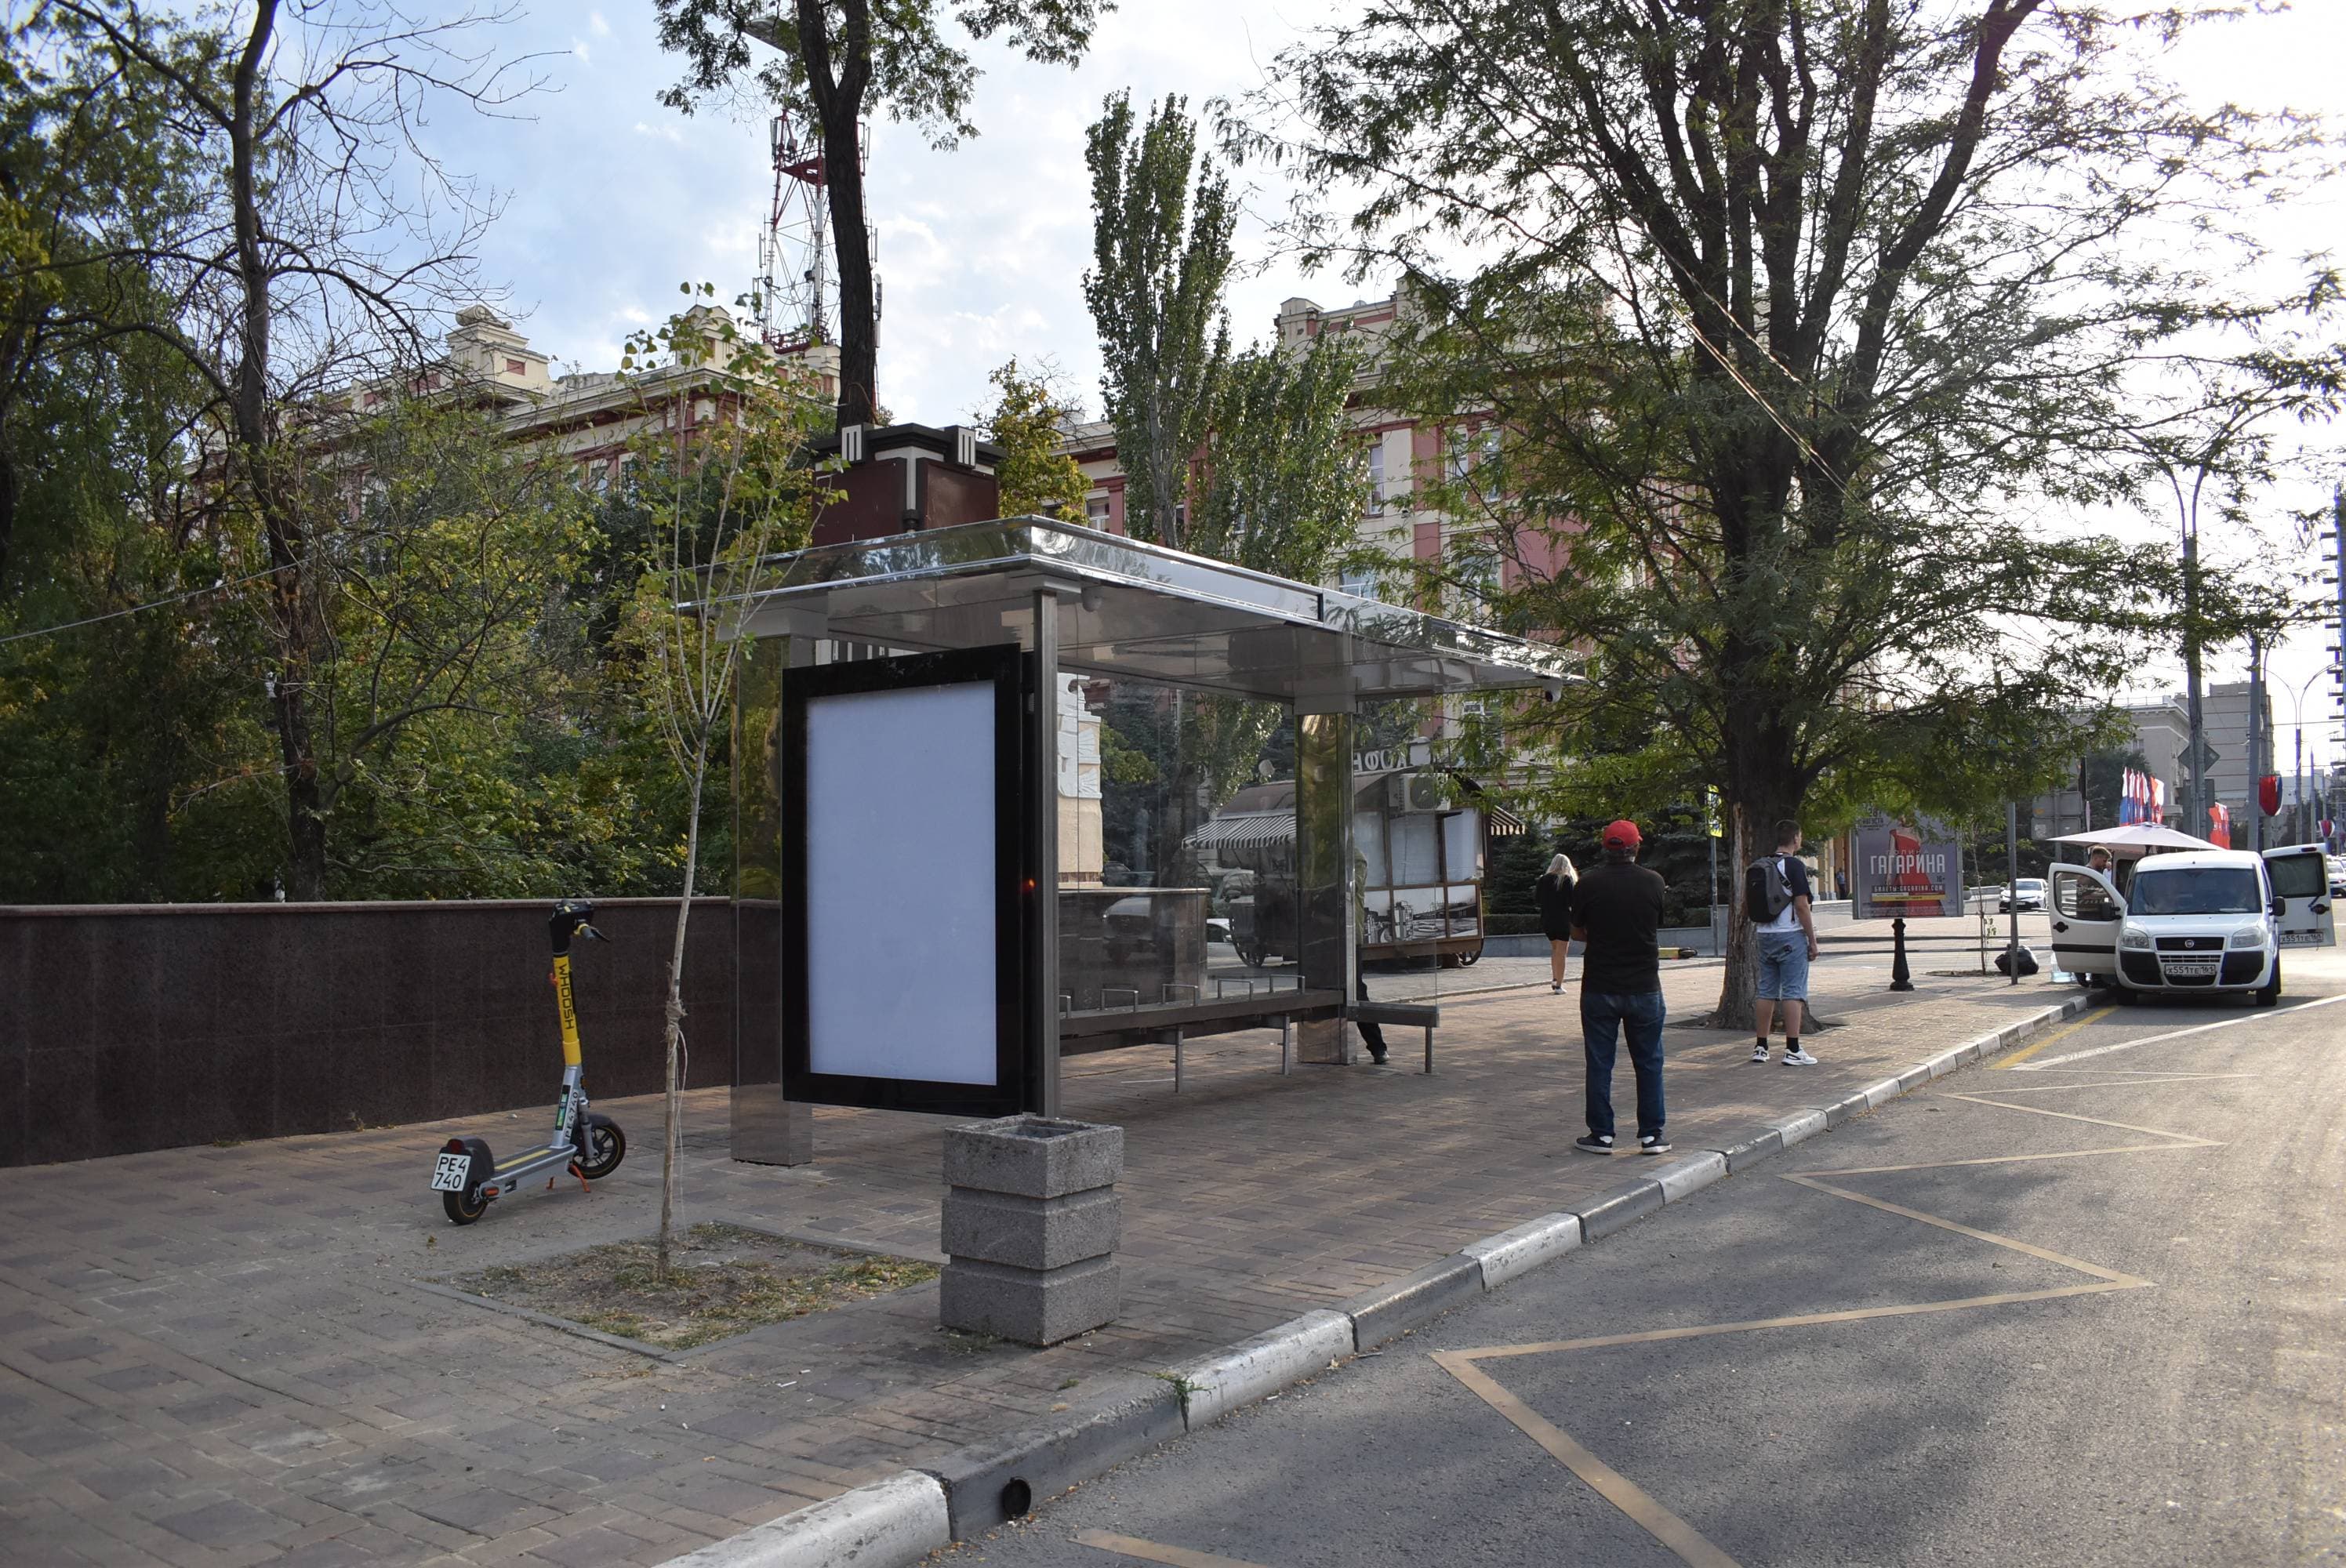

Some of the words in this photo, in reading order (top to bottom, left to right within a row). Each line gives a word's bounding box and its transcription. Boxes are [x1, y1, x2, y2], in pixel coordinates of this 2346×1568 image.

[1870, 854, 1945, 874] ГАГАРИНА
[558, 964, 575, 1029] WHOOSH
[434, 1172, 462, 1189] 740
